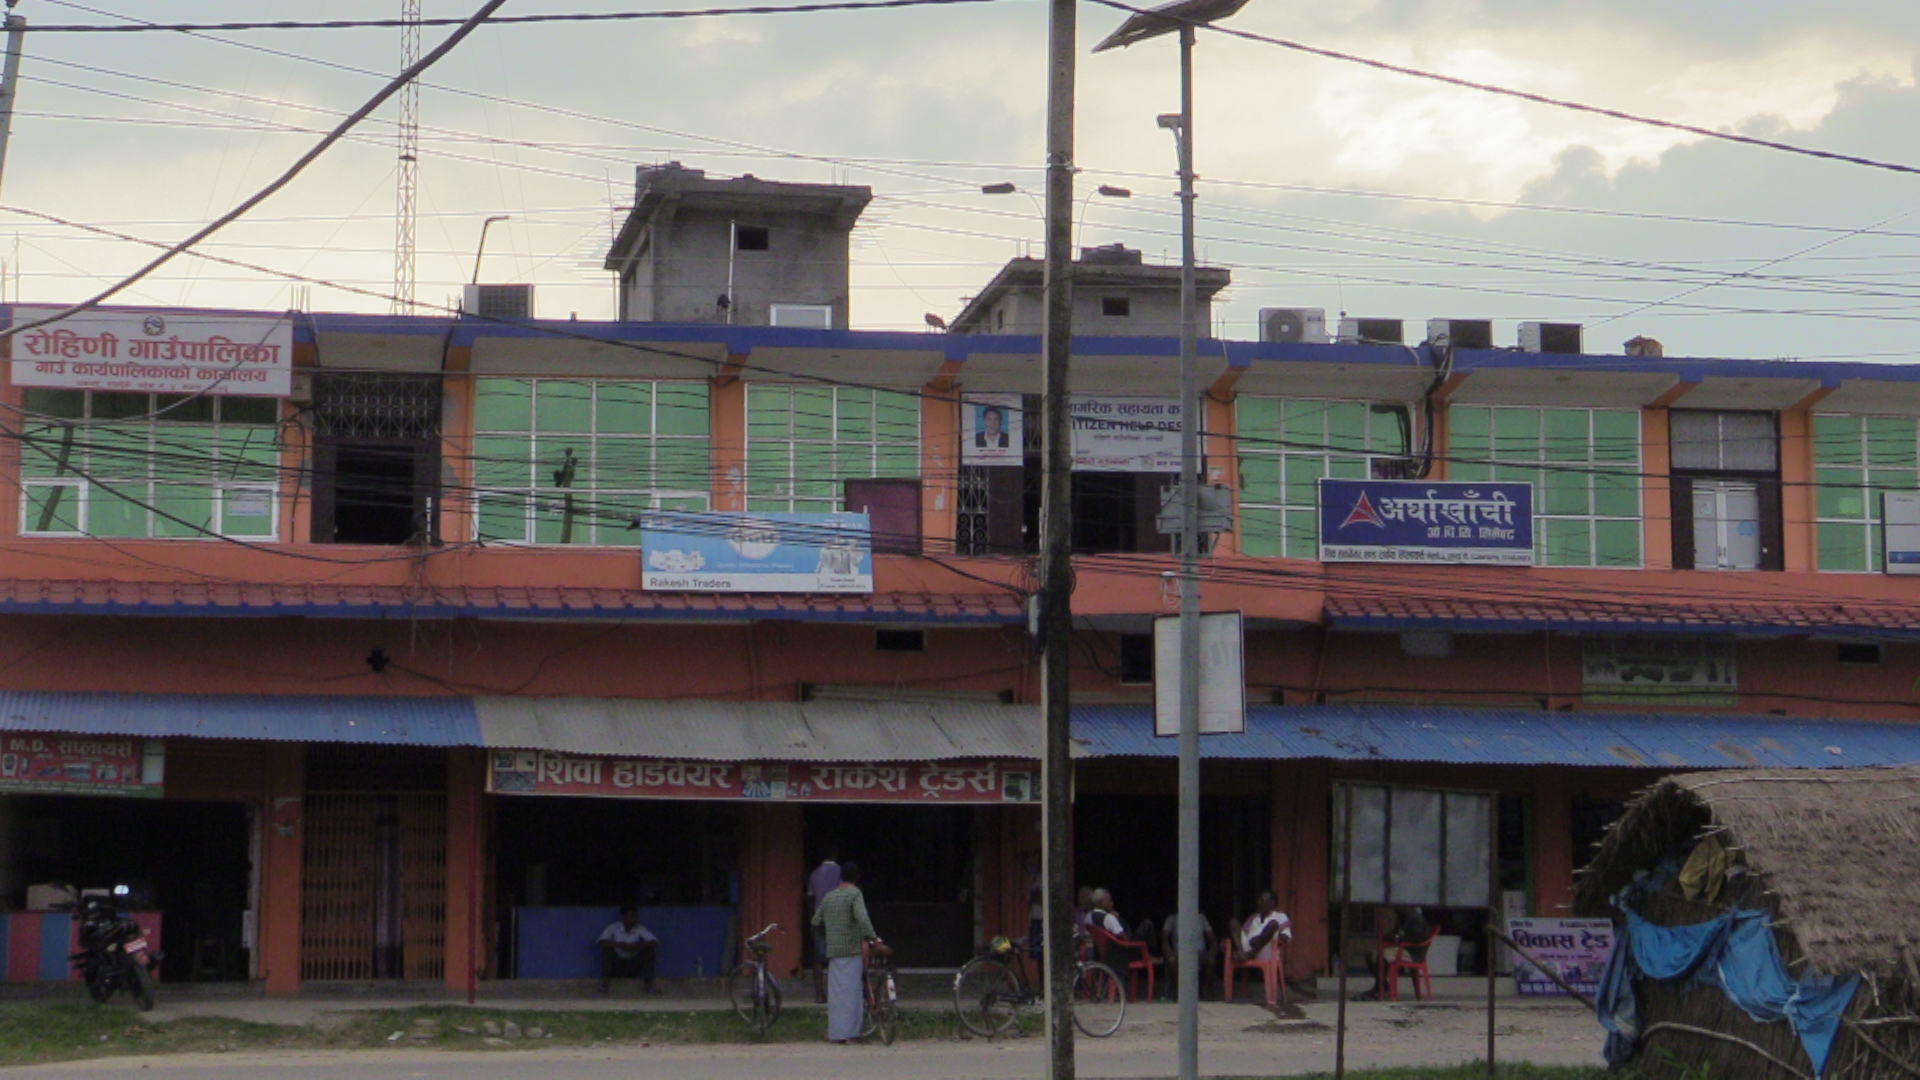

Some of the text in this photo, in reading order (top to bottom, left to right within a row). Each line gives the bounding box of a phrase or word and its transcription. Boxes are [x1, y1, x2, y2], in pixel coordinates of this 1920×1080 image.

[24, 329, 281, 363] रोहिणी गाउँपालिका
[1071, 417, 1117, 431] ITIZEN
[1158, 421, 1181, 434] DES
[1378, 489, 1516, 525] अर्घाखाँची
[650, 577, 731, 588] Rakesh Traders
[10, 739, 50, 752] M.D.
[1512, 929, 1576, 950] विकास
